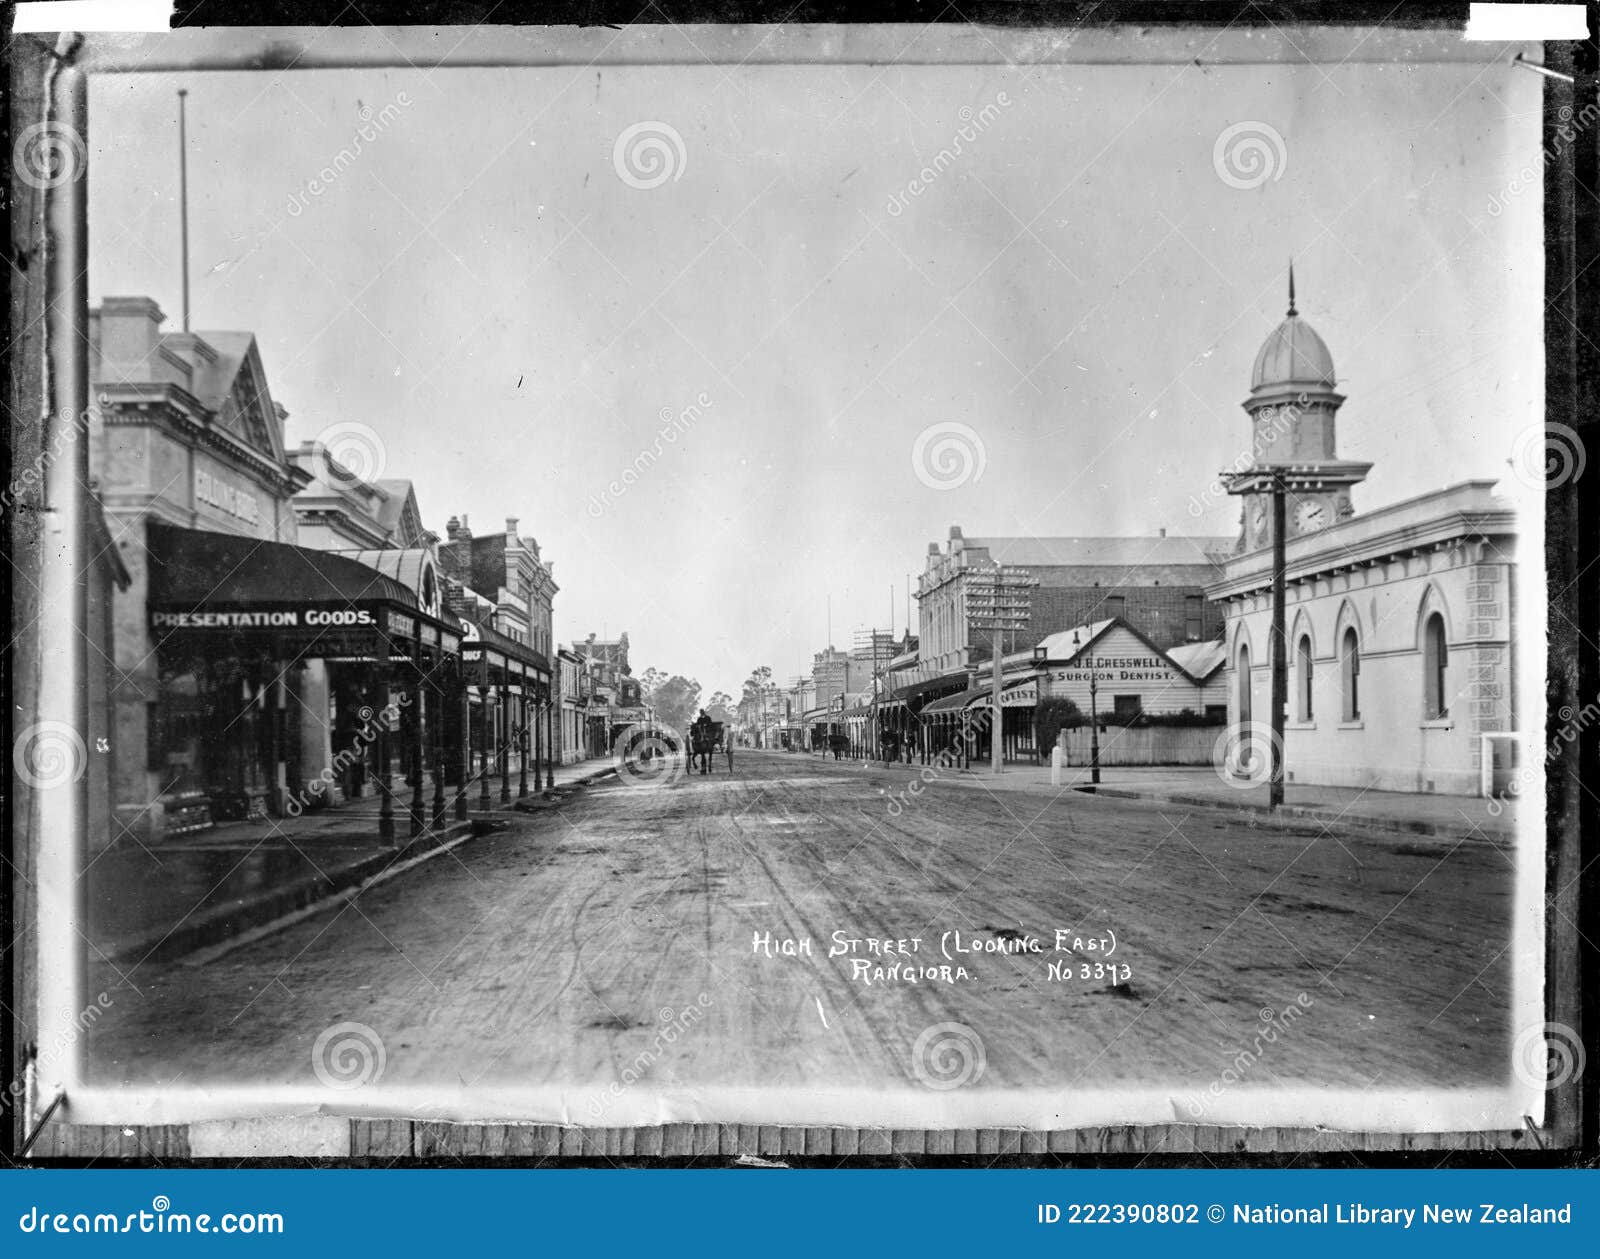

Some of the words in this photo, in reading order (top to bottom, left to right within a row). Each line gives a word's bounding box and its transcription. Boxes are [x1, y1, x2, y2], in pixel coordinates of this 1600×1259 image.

[153, 611, 298, 627] PRESENTATION
[304, 610, 377, 625] GOODS.
[1120, 670, 1175, 680] DENTIST.
[985, 689, 1036, 705] DNTIST
